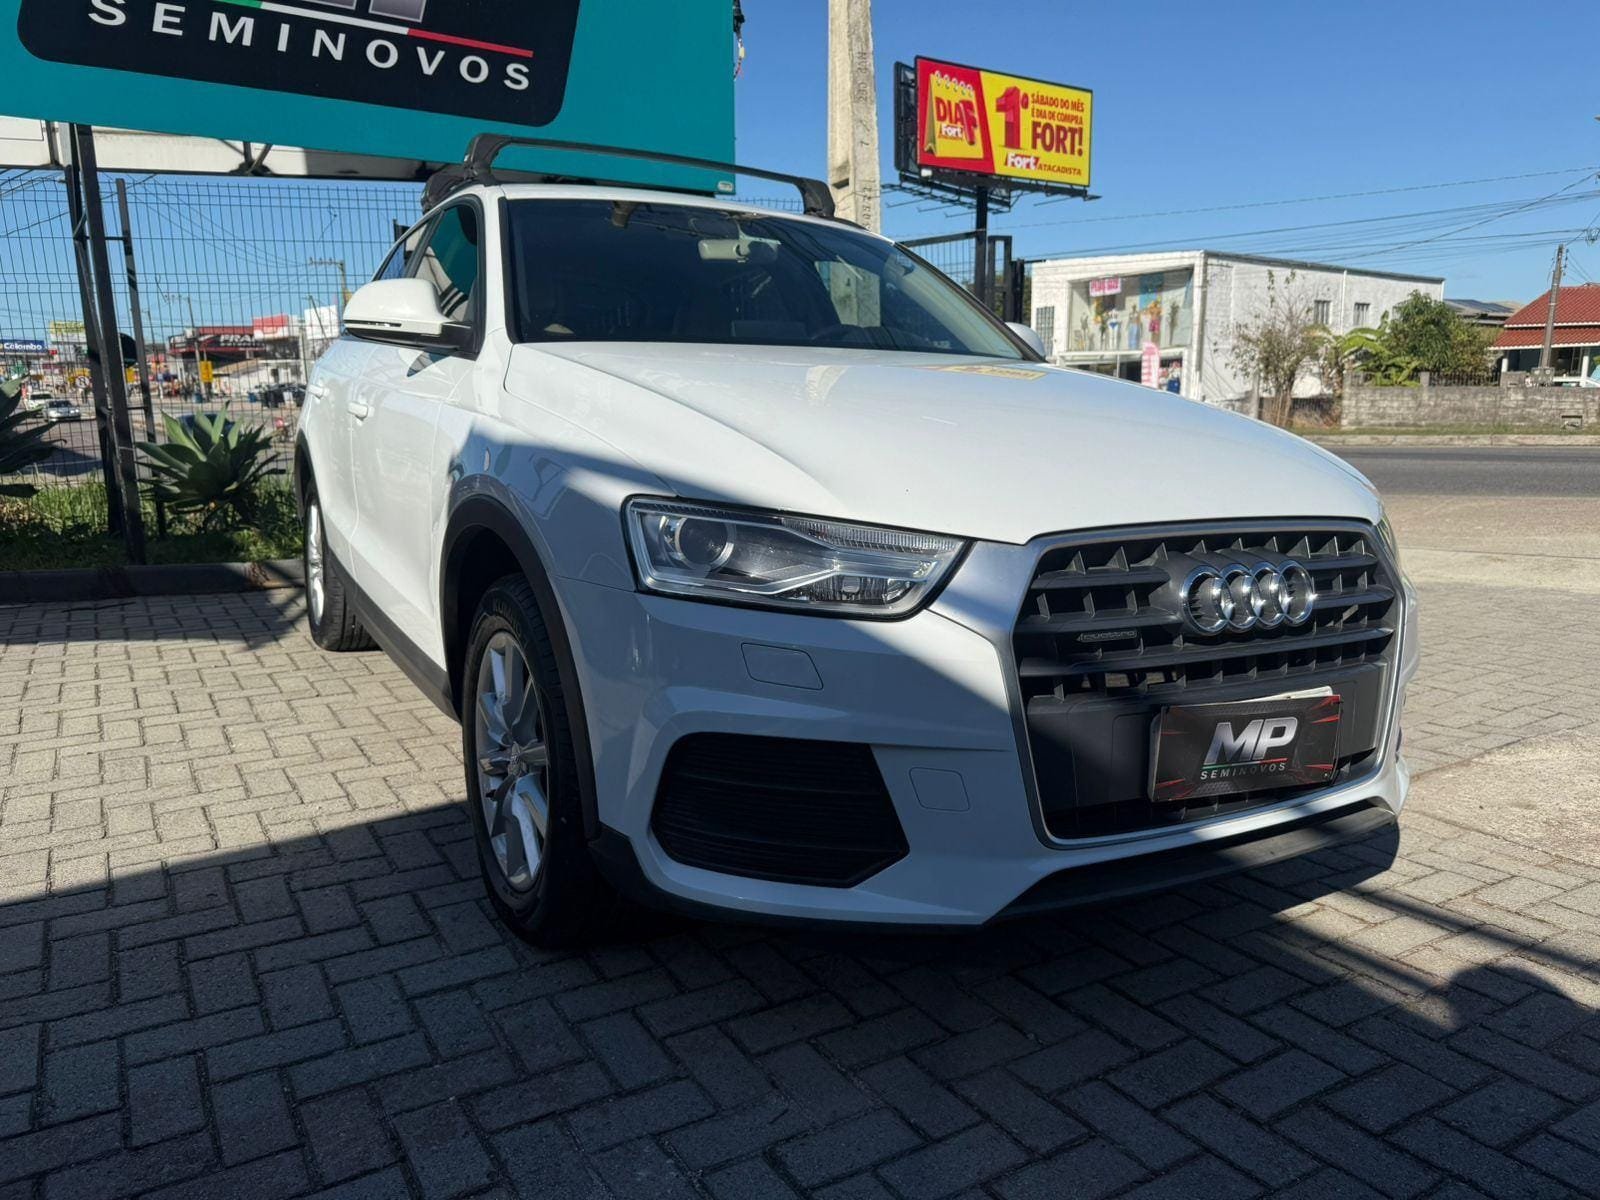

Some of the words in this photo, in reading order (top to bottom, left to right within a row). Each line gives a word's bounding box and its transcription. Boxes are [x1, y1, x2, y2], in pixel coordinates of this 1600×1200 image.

[88, 0, 530, 90] SEMINOVOS
[1031, 91, 1059, 108] SÁBADO
[1060, 98, 1070, 110] DO
[1070, 99, 1085, 112] MÊS
[1036, 108, 1047, 119] DIA
[1047, 110, 1056, 121] DE
[1056, 112, 1083, 125] COMPRA
[941, 123, 963, 137] Fort
[1031, 120, 1084, 157] FORT!
[1006, 152, 1037, 171] Fort
[1037, 163, 1082, 176] ATACADISTA
[3, 342, 42, 350] Colombo
[1203, 717, 1298, 765] MP
[1200, 762, 1286, 780] SEMINOVOS
